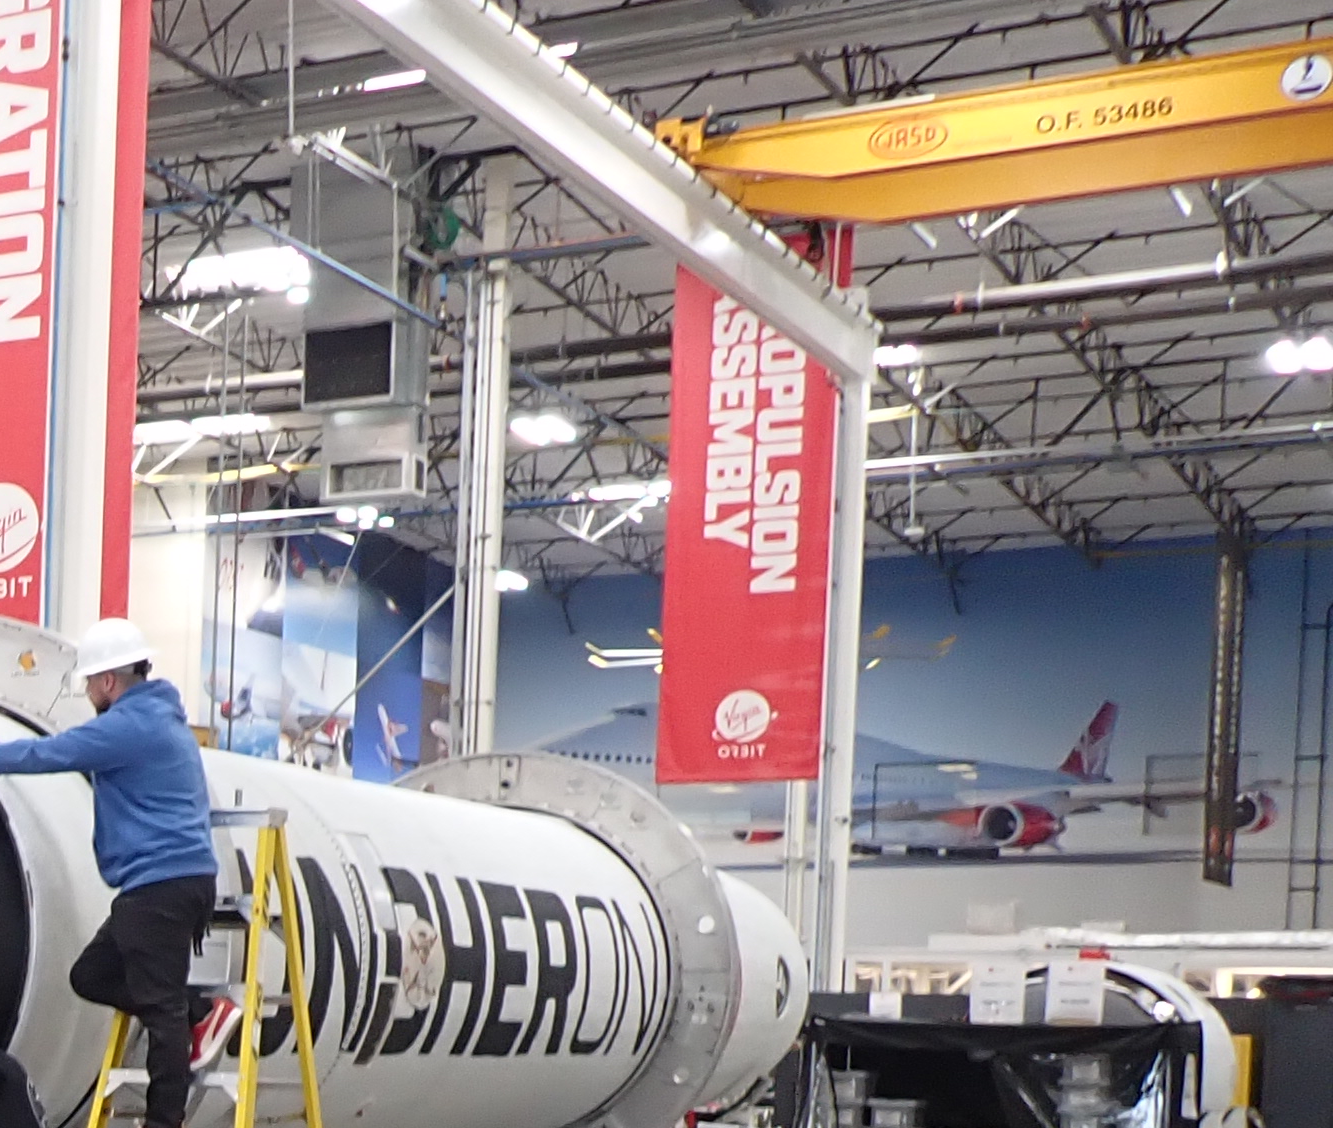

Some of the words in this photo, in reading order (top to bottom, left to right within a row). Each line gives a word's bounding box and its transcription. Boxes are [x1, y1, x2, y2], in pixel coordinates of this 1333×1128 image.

[1094, 96, 1173, 126] 53486
[703, 294, 759, 549] SSEMBLY
[749, 325, 807, 594] OPULSION
[717, 743, 766, 759] ORBIT
